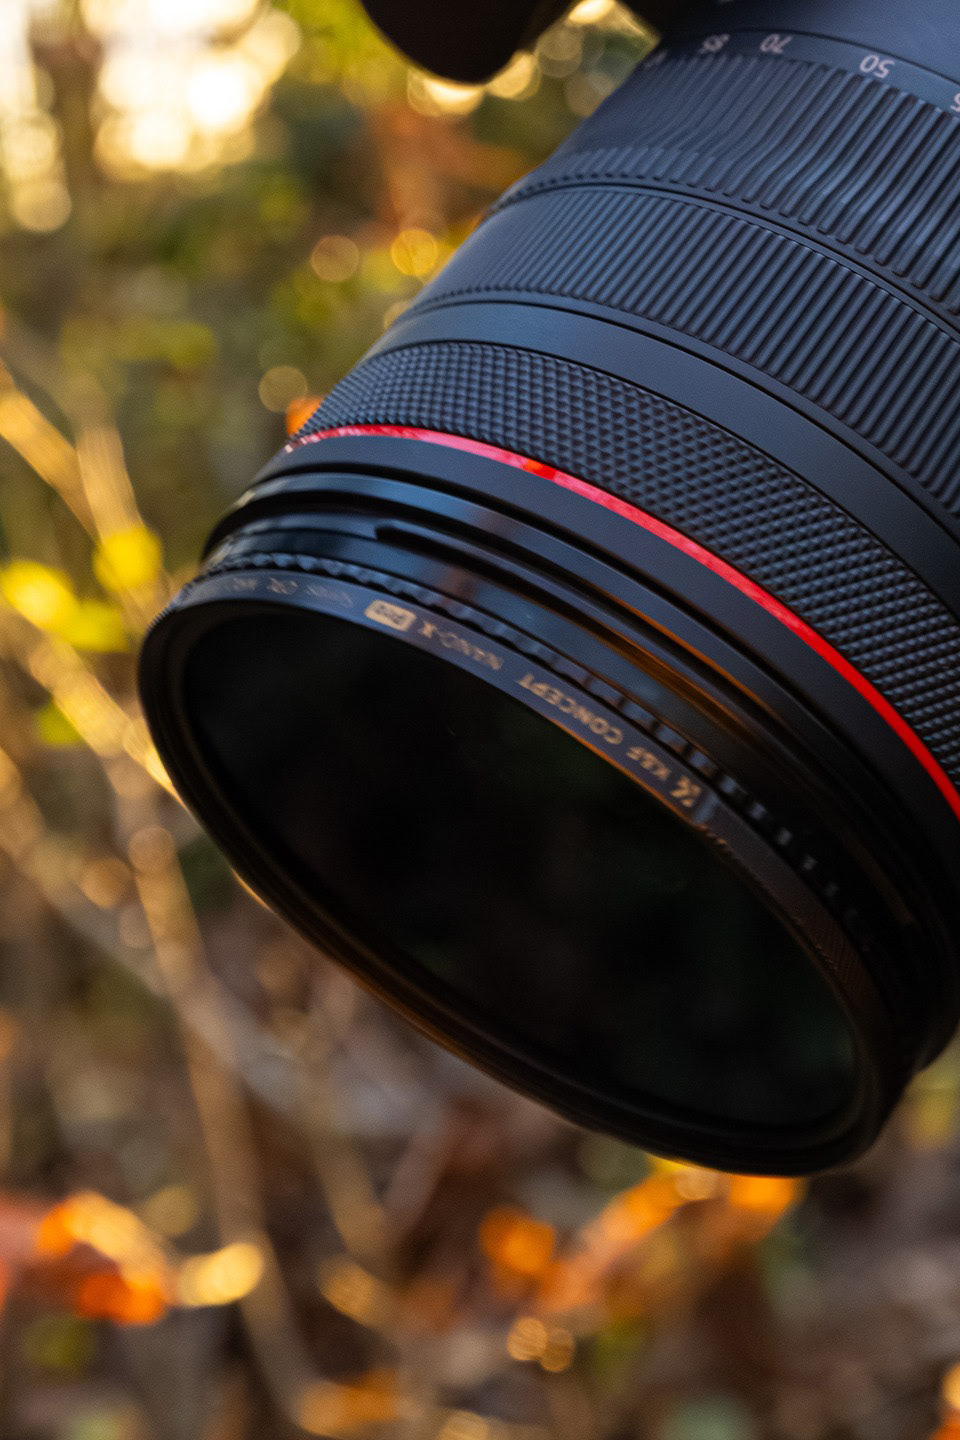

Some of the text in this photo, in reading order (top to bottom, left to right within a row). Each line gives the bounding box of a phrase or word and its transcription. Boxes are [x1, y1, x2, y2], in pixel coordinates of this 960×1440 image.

[759, 34, 793, 55] 70
[859, 54, 895, 79] 50
[516, 673, 625, 745] CONCEPT
[626, 746, 672, 782] K&F
